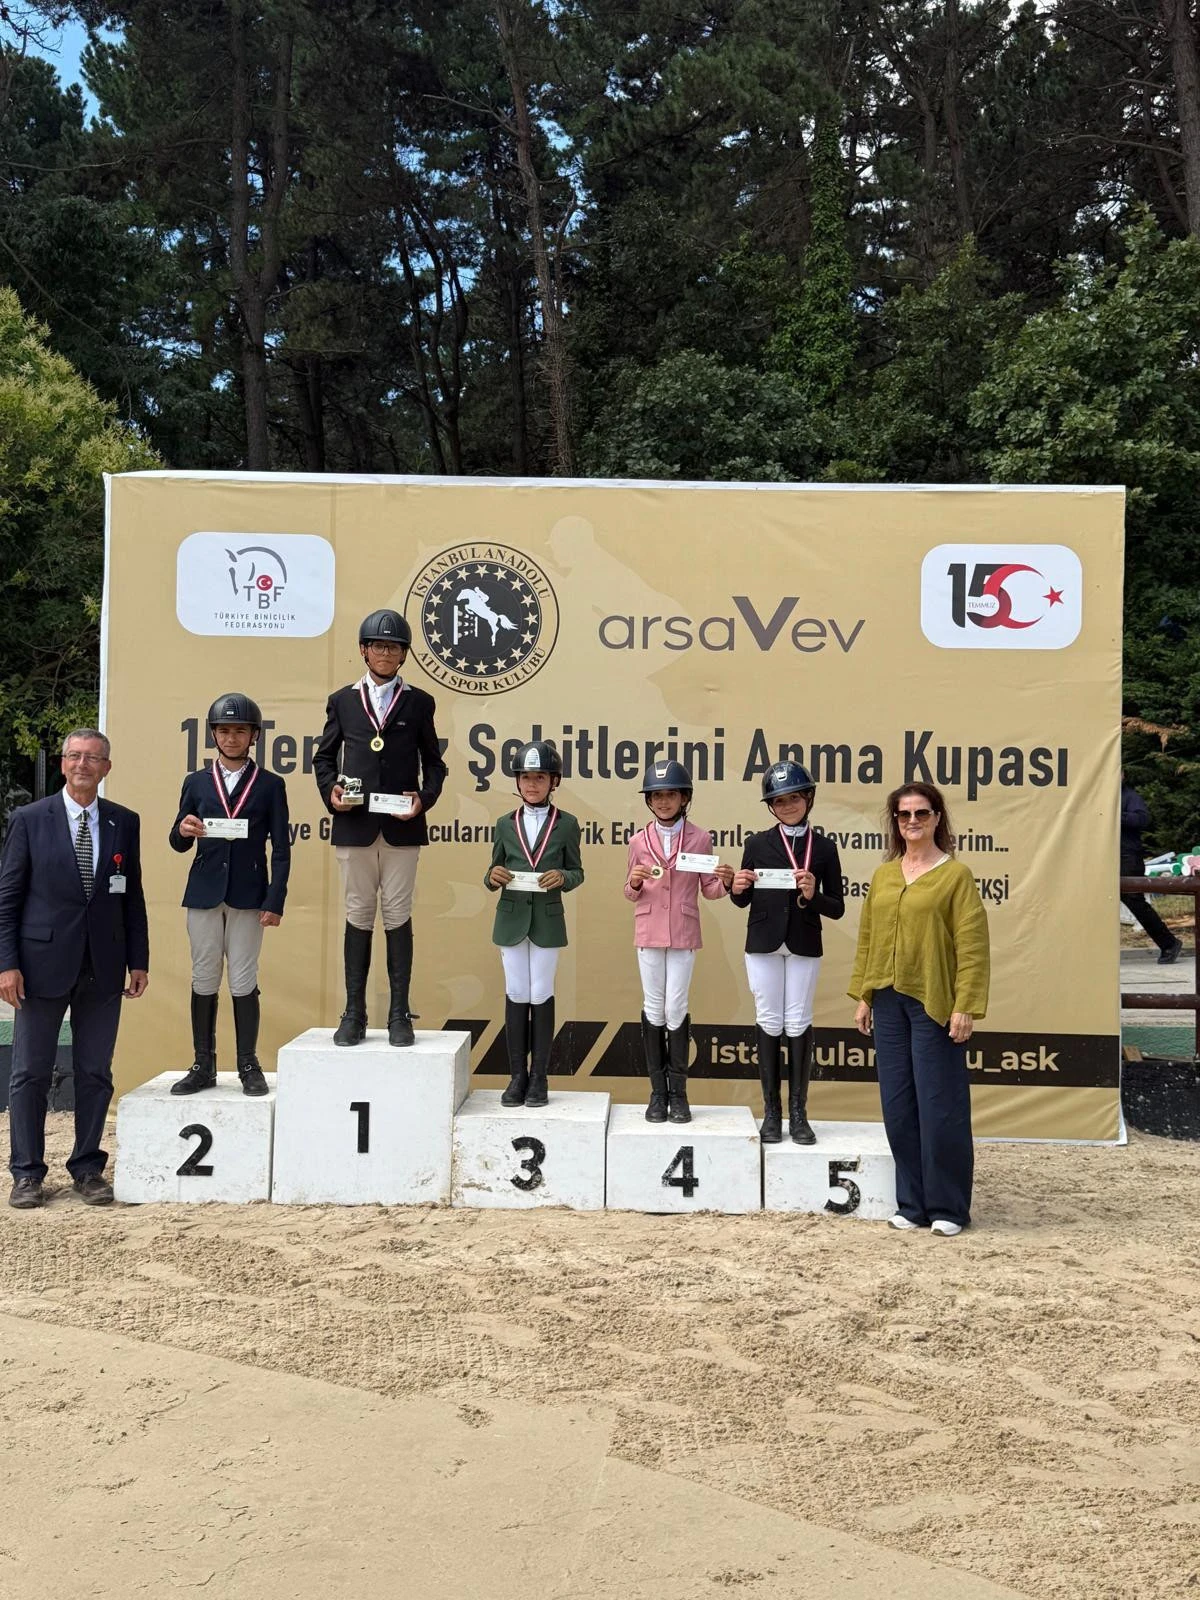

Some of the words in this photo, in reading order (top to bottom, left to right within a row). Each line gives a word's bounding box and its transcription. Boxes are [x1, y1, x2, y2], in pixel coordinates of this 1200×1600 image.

[412, 547, 481, 599] İSTANBUL
[485, 548, 551, 599] ANADOLU
[214, 612, 250, 620] TÜRKİYE
[254, 613, 296, 621] BİNİCİLİK
[225, 621, 285, 629] FEDERASYONU
[417, 651, 451, 681] ATLI
[450, 674, 490, 692] SPOR
[493, 646, 547, 691] KULÜBÜ
[904, 730, 1068, 801] Kupası
[176, 1123, 214, 1177] 2
[350, 1101, 370, 1153] 1
[510, 1136, 546, 1191] 3
[661, 1146, 699, 1198] 4
[824, 1161, 861, 1215] 5
